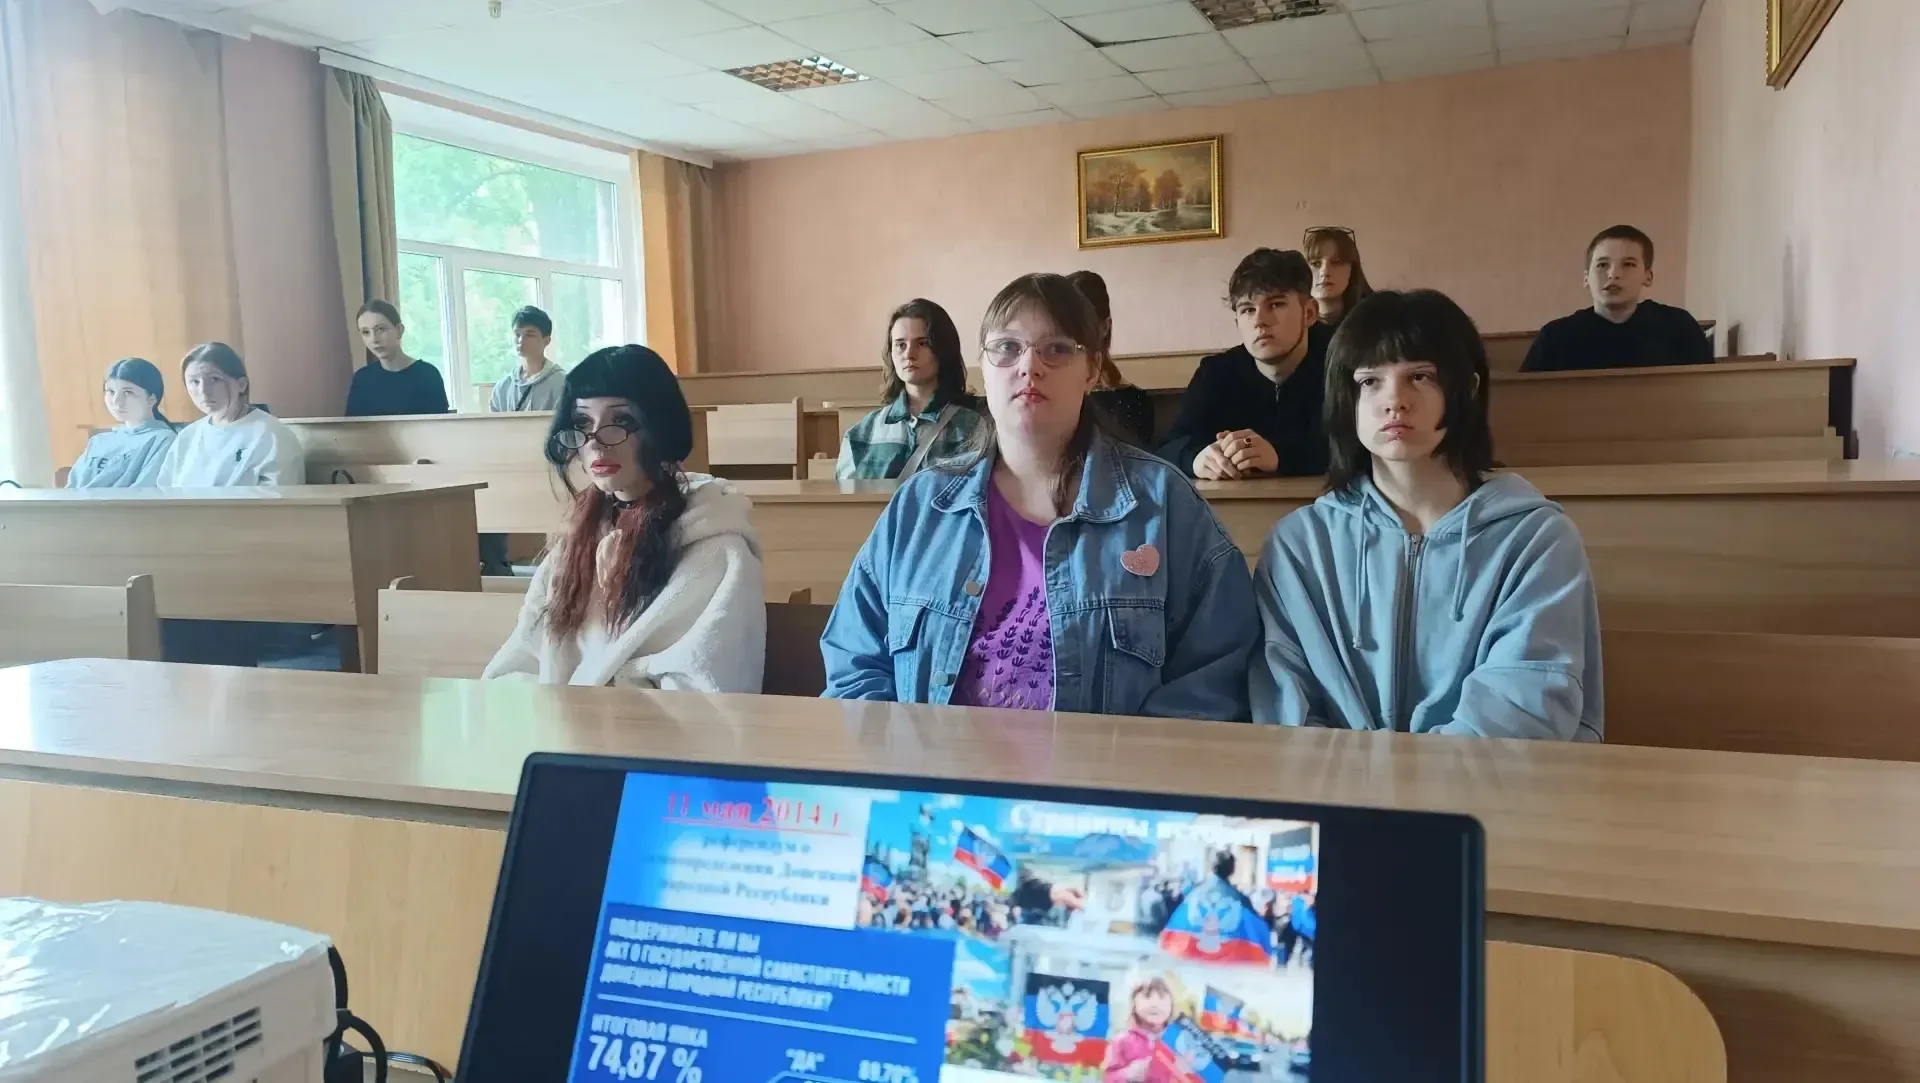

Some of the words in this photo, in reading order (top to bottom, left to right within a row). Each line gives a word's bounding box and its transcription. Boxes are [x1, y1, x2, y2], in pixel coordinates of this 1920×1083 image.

[666, 791, 692, 818] 11
[758, 795, 822, 827] 2014
[588, 1035, 667, 1081] 74,87
[671, 1047, 703, 1083] %
